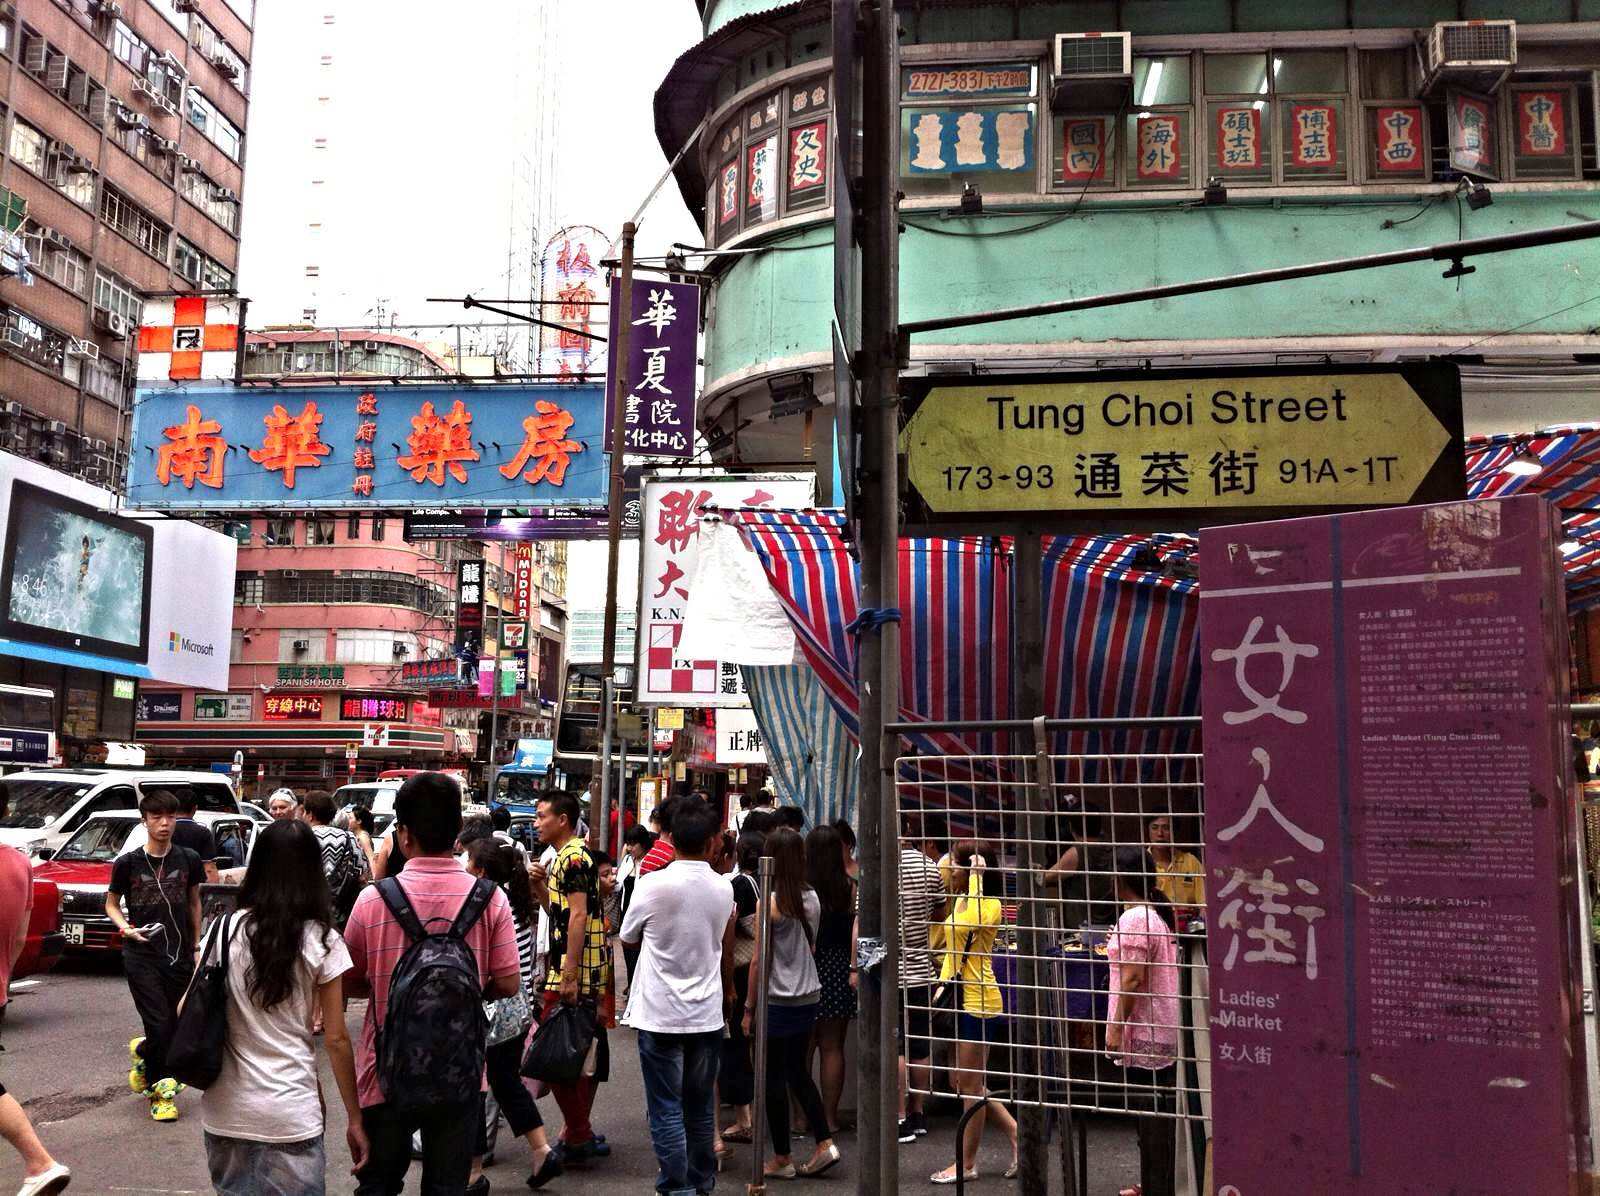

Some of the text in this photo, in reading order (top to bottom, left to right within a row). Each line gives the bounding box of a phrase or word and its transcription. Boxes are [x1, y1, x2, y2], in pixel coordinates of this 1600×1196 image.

[797, 131, 818, 178] 文史
[1145, 123, 1172, 169] 海外
[1225, 112, 1251, 163] 碩士班
[1300, 110, 1326, 159] 博士班
[1387, 112, 1413, 160] 中西
[631, 289, 677, 394] 華夏
[625, 394, 681, 425] 書院
[987, 389, 1347, 435] Tung Choi Street
[156, 400, 583, 489] 南華藥房
[352, 392, 378, 496] 政府註冊
[942, 450, 1398, 498] 173-93 通菜街 91A-1T
[654, 560, 689, 601] 大
[652, 608, 685, 620] K.N.
[181, 637, 214, 657] Microsoft
[265, 697, 323, 713] 穿線中心
[318, 678, 348, 687] HOTEL
[728, 729, 763, 753] 正牌
[1211, 616, 1325, 980] 女人街
[1219, 988, 1280, 1009] Ladies'
[1219, 1009, 1283, 1032] Market
[1219, 1042, 1272, 1065] 女人街
